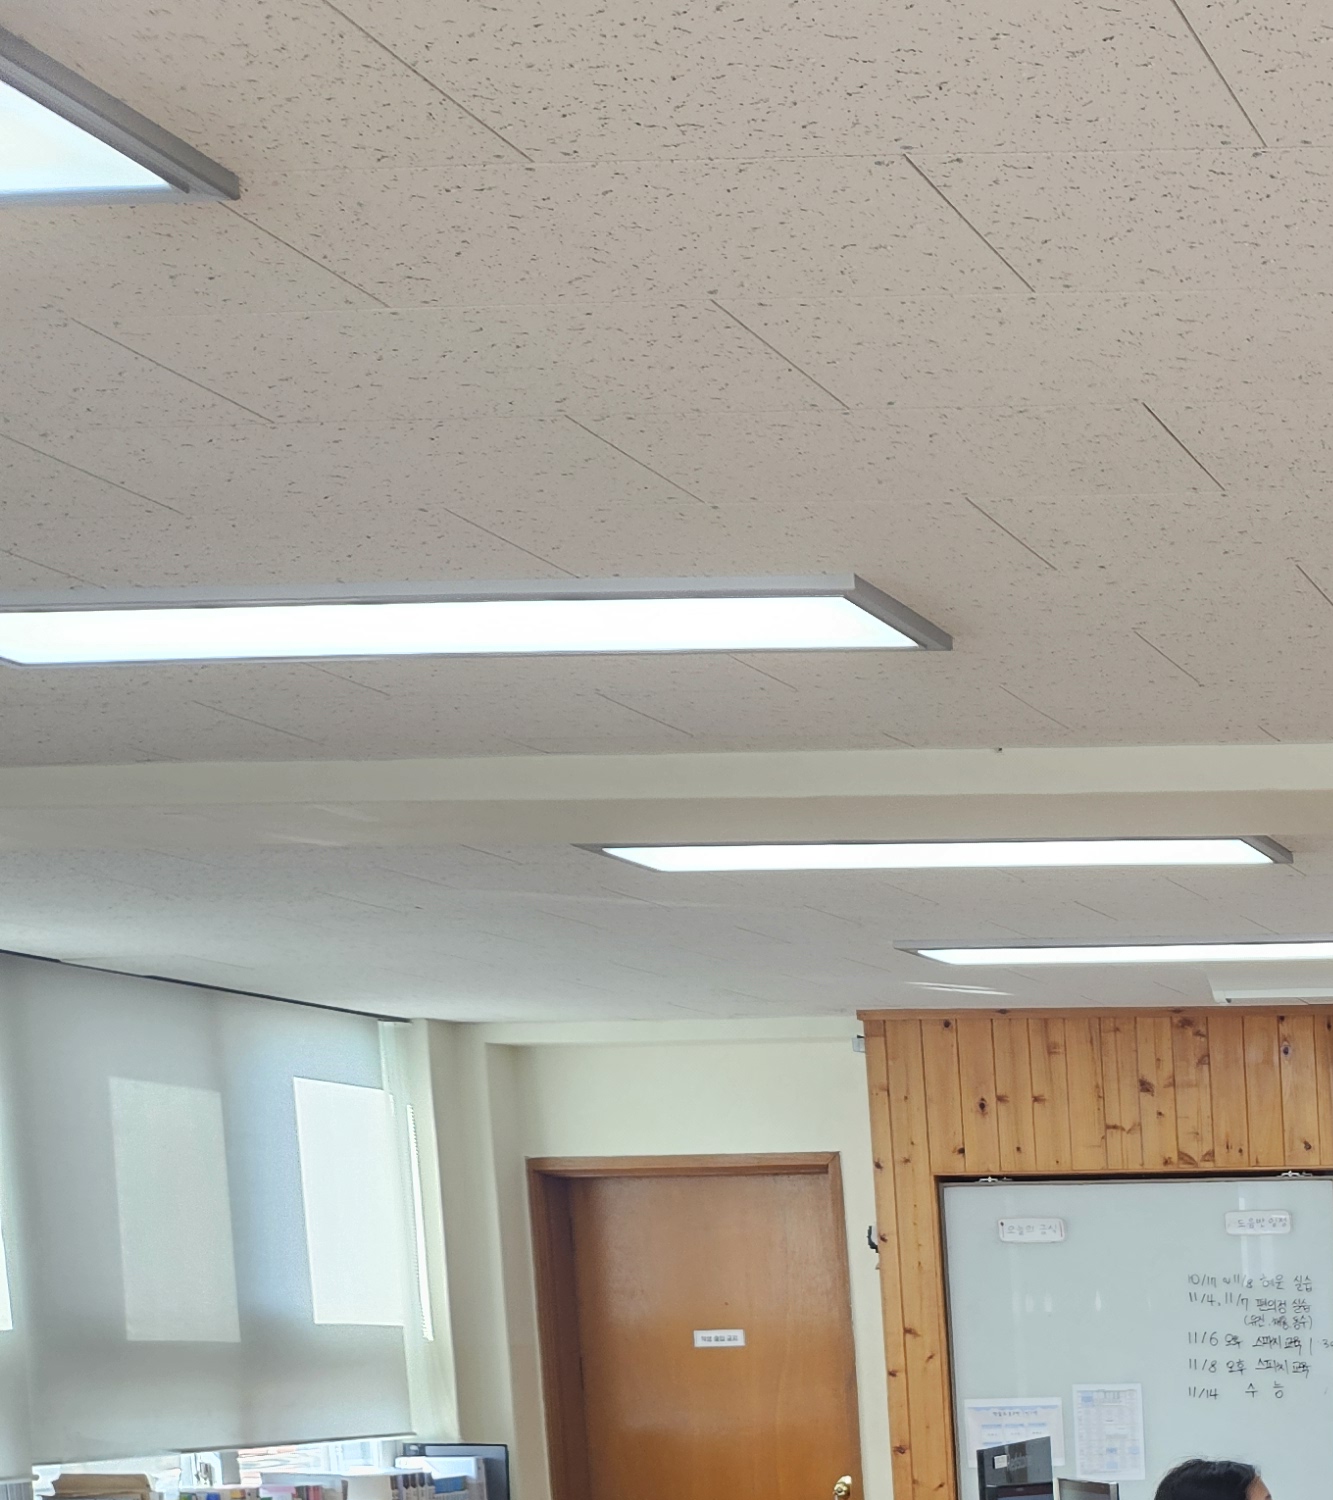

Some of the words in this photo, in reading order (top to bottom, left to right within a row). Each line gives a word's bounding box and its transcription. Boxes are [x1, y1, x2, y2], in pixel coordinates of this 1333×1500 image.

[1293, 1274, 1313, 1292] 실습
[1255, 1298, 1287, 1314] 편의점
[1291, 1298, 1312, 1314] 실습
[1188, 1331, 1219, 1347] 11/6
[1188, 1358, 1218, 1374] 11/8
[1225, 1358, 1247, 1376] 오후
[1188, 1386, 1220, 1401] 11/14
